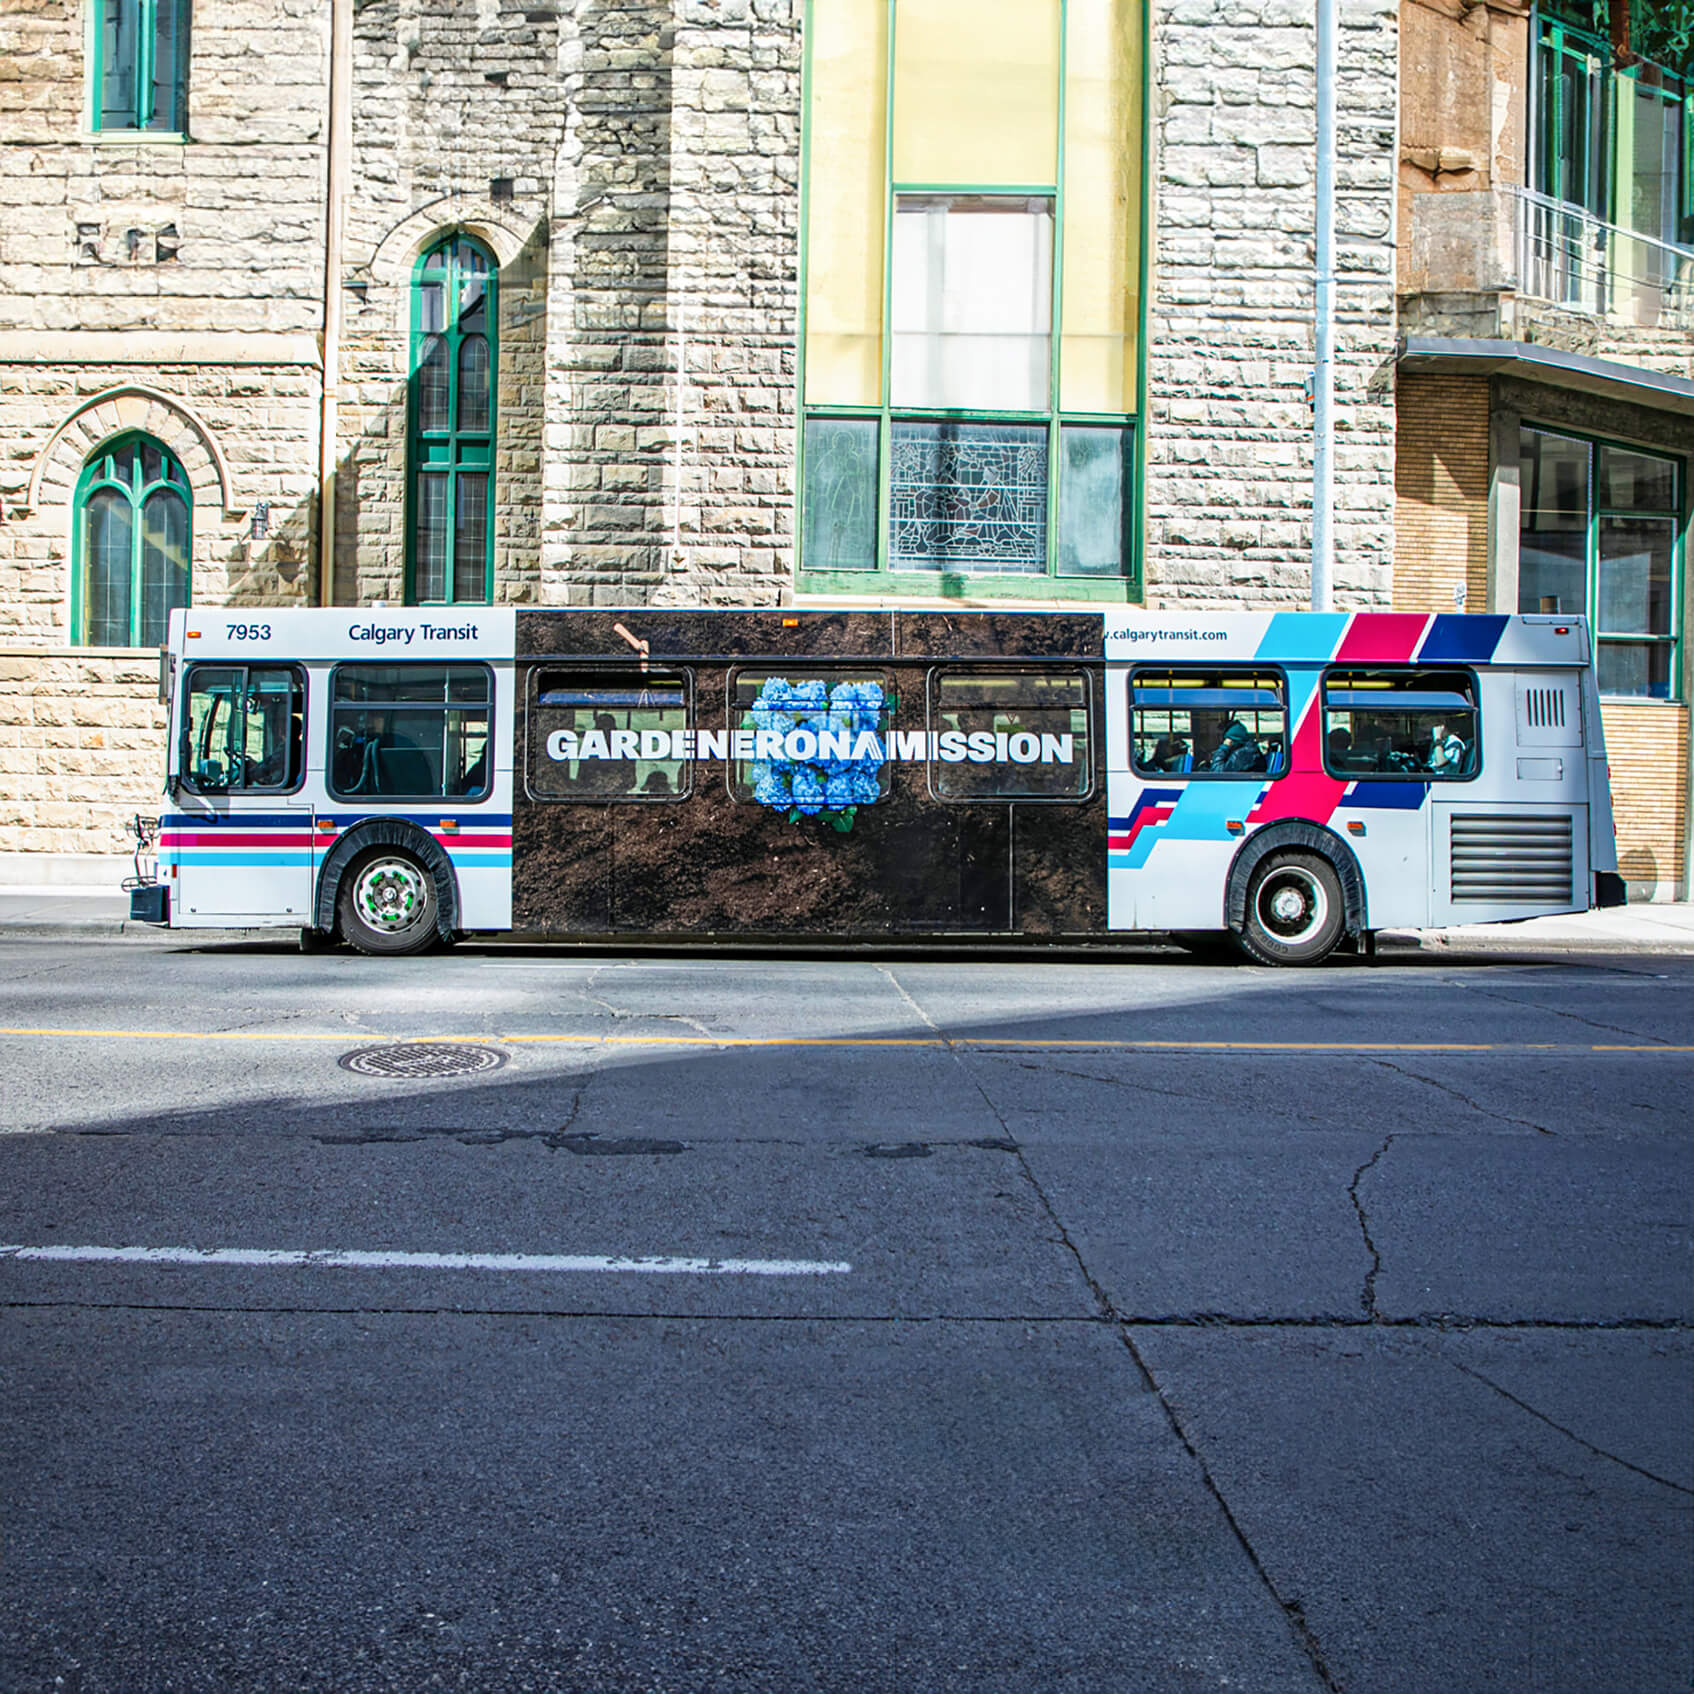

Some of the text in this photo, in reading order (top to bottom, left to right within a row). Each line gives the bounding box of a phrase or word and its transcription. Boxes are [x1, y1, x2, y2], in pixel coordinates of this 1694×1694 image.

[226, 624, 272, 640] 7953
[348, 623, 479, 645] Calgary Transit
